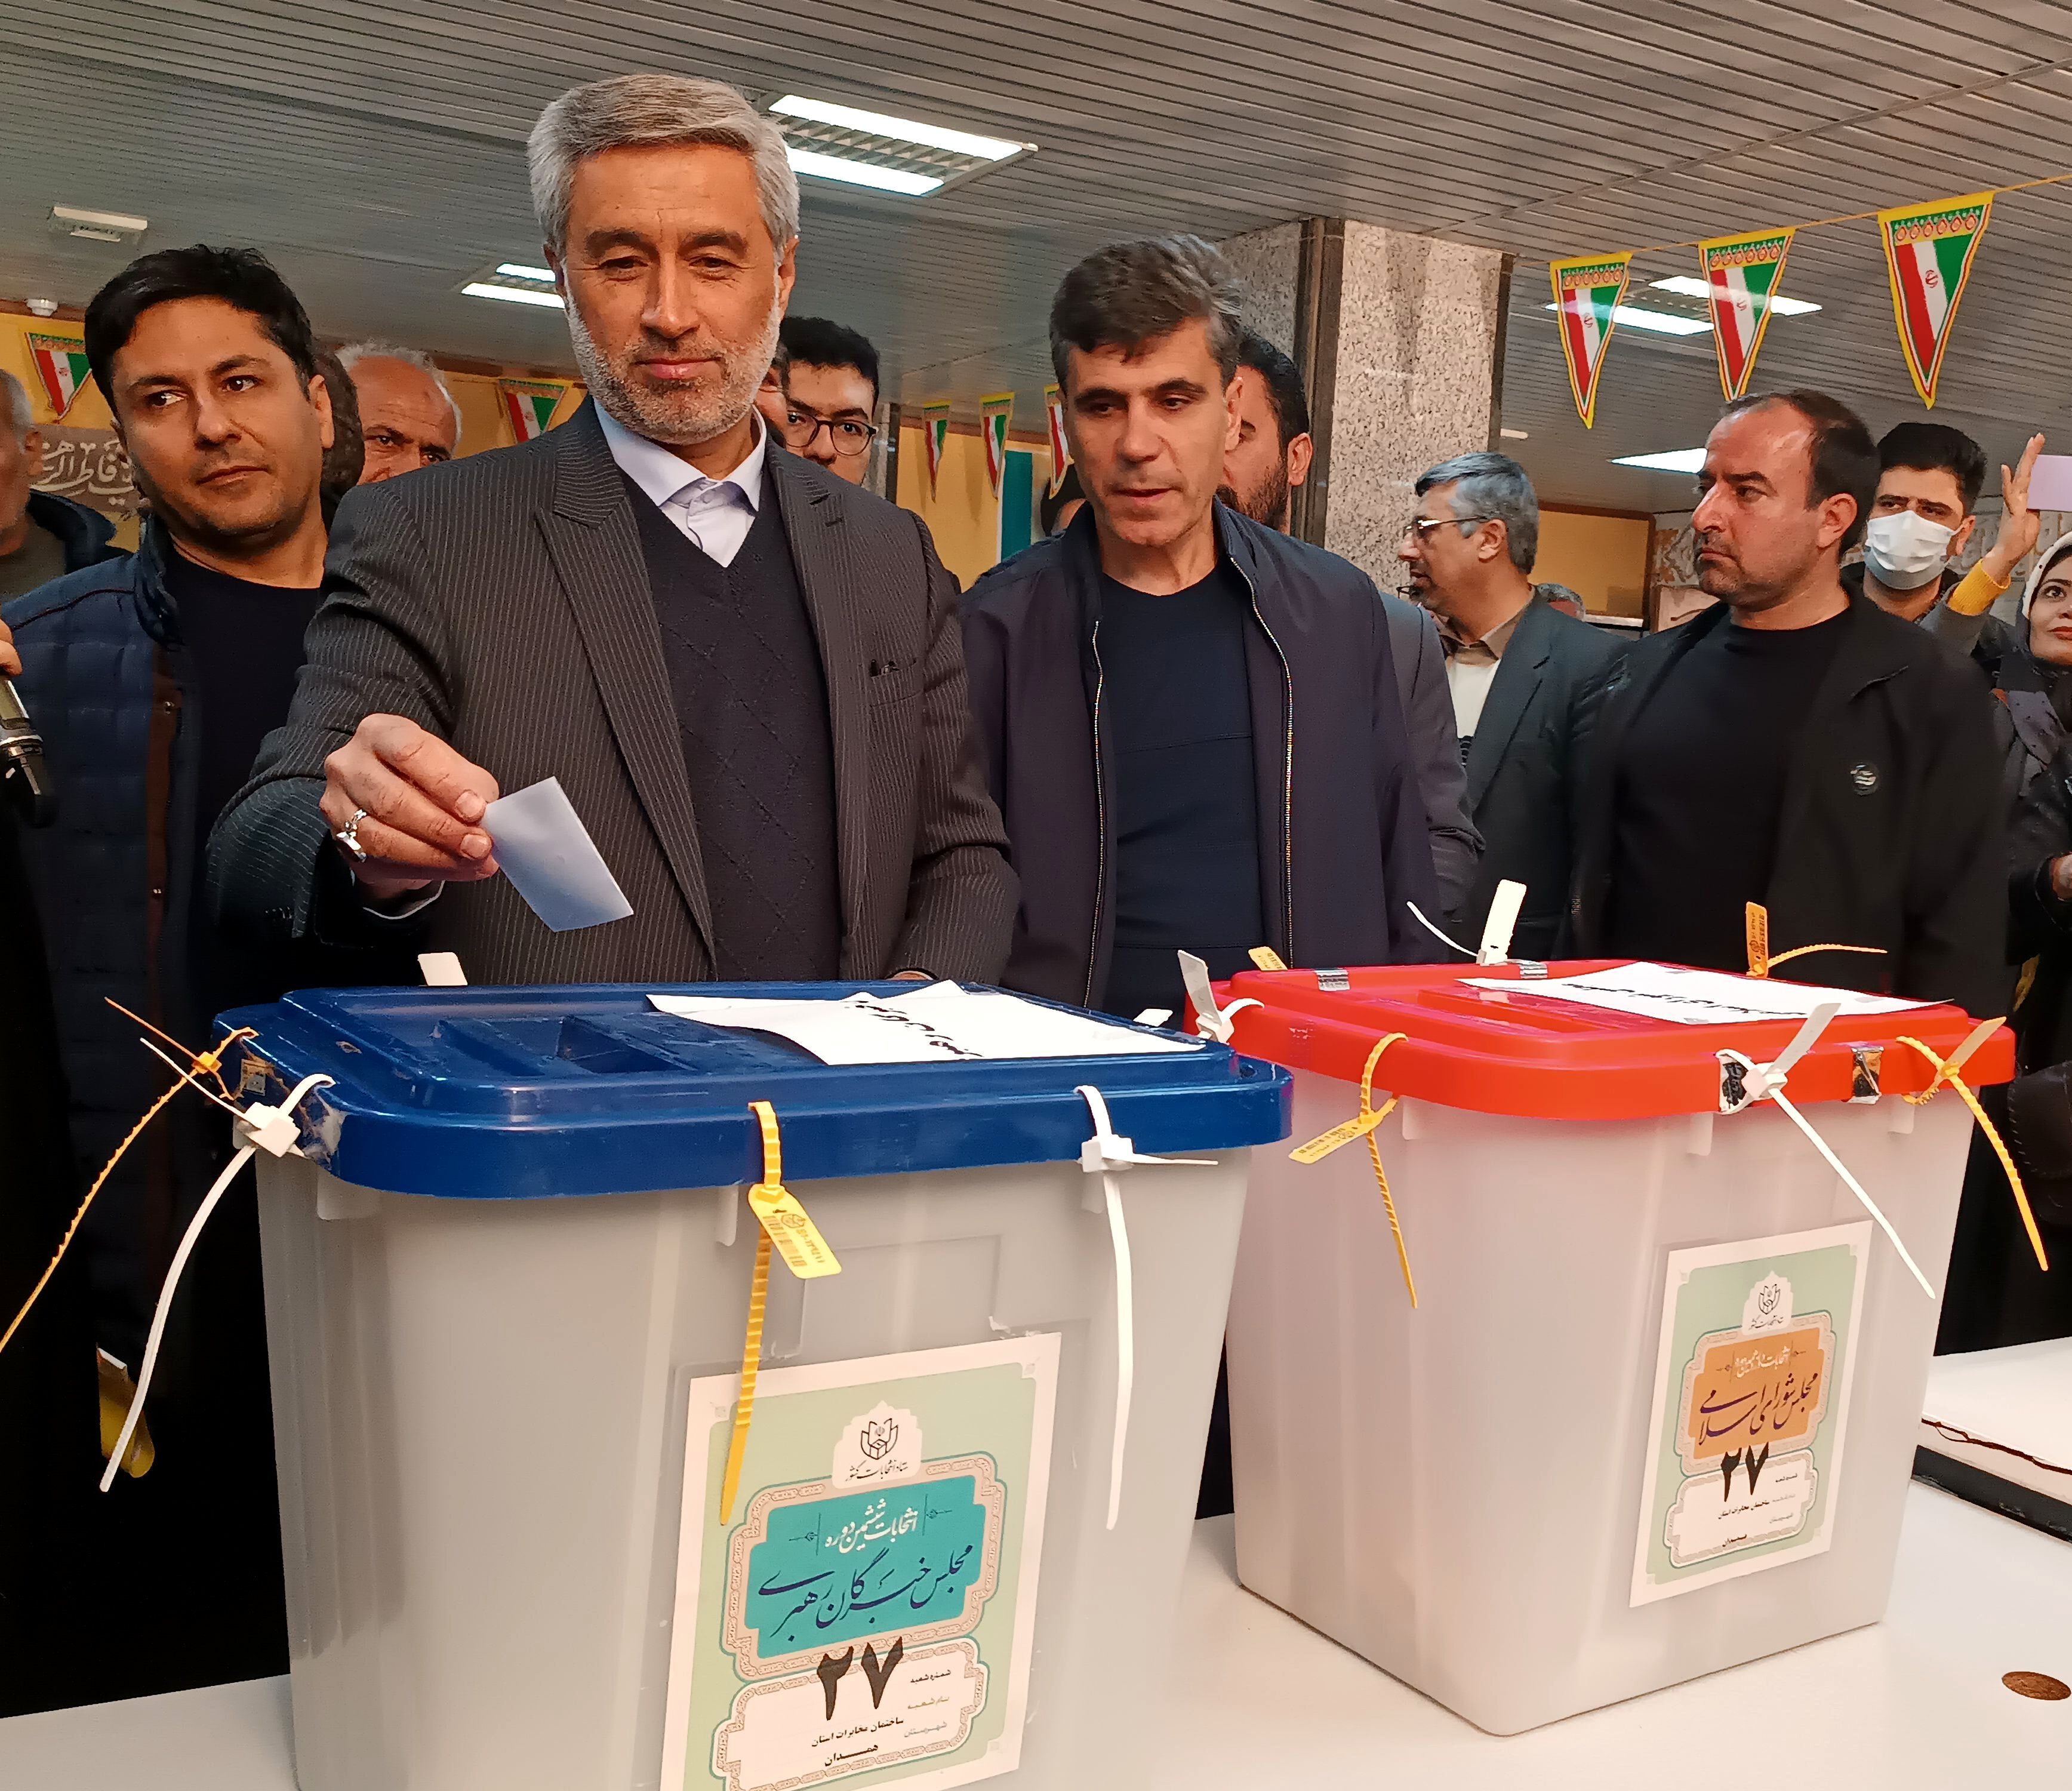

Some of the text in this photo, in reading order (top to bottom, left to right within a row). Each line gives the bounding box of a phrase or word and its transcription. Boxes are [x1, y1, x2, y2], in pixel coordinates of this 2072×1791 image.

[1698, 1373, 1818, 1446] مجلس شورای اسلامی
[1720, 1441, 1769, 1503] ۲۷
[825, 1498, 919, 1553] انتخابات ششمین دوره
[758, 1544, 974, 1642] مجلس خبرگان رهبری
[817, 1636, 904, 1721] ۲۷
[811, 1732, 835, 1747] استان
[824, 1744, 879, 1767] همدان
